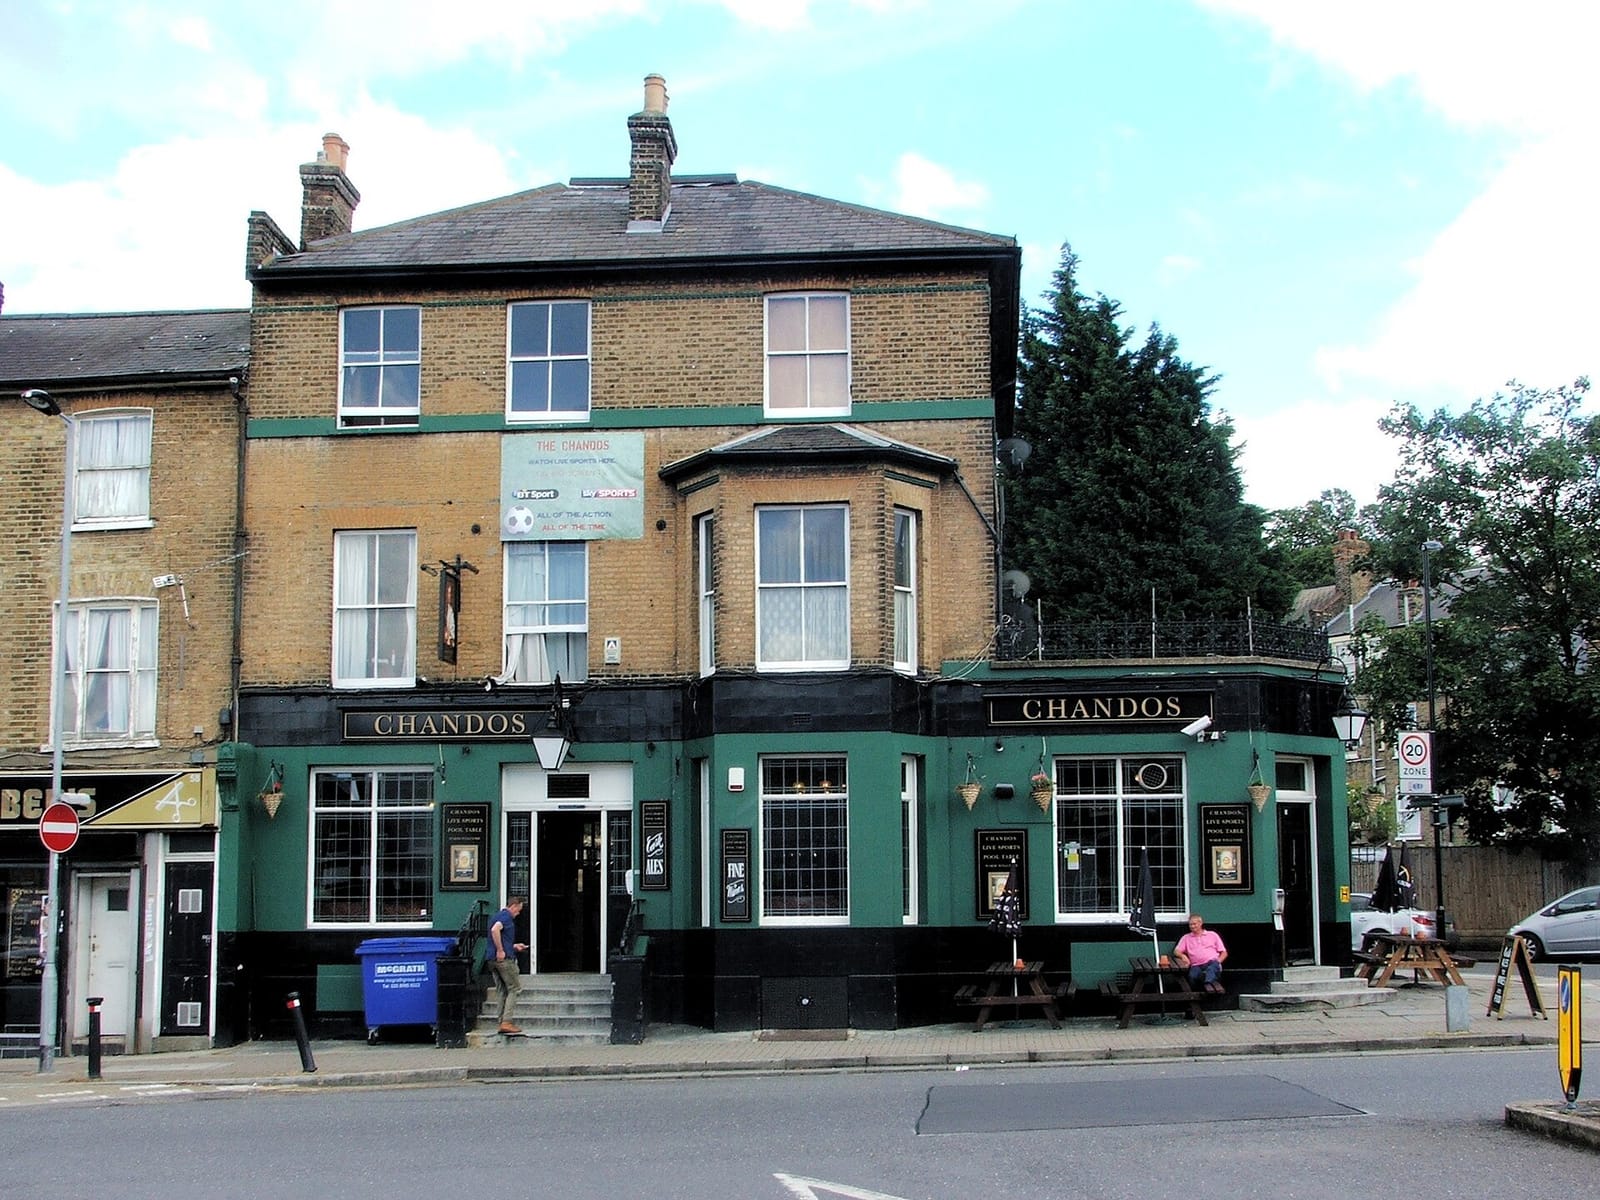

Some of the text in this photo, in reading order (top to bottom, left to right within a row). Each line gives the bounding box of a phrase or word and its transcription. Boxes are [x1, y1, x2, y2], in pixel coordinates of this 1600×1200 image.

[536, 440, 610, 452] THE CHANDOS
[532, 489, 555, 500] Sport
[599, 489, 636, 497] SPORTS
[1022, 696, 1181, 720] CHANDOS
[374, 713, 526, 735] CHANDOS
[1406, 744, 1423, 757] 20
[1403, 768, 1427, 776] ZONE
[646, 859, 664, 875] ALES
[728, 862, 744, 878] FINE
